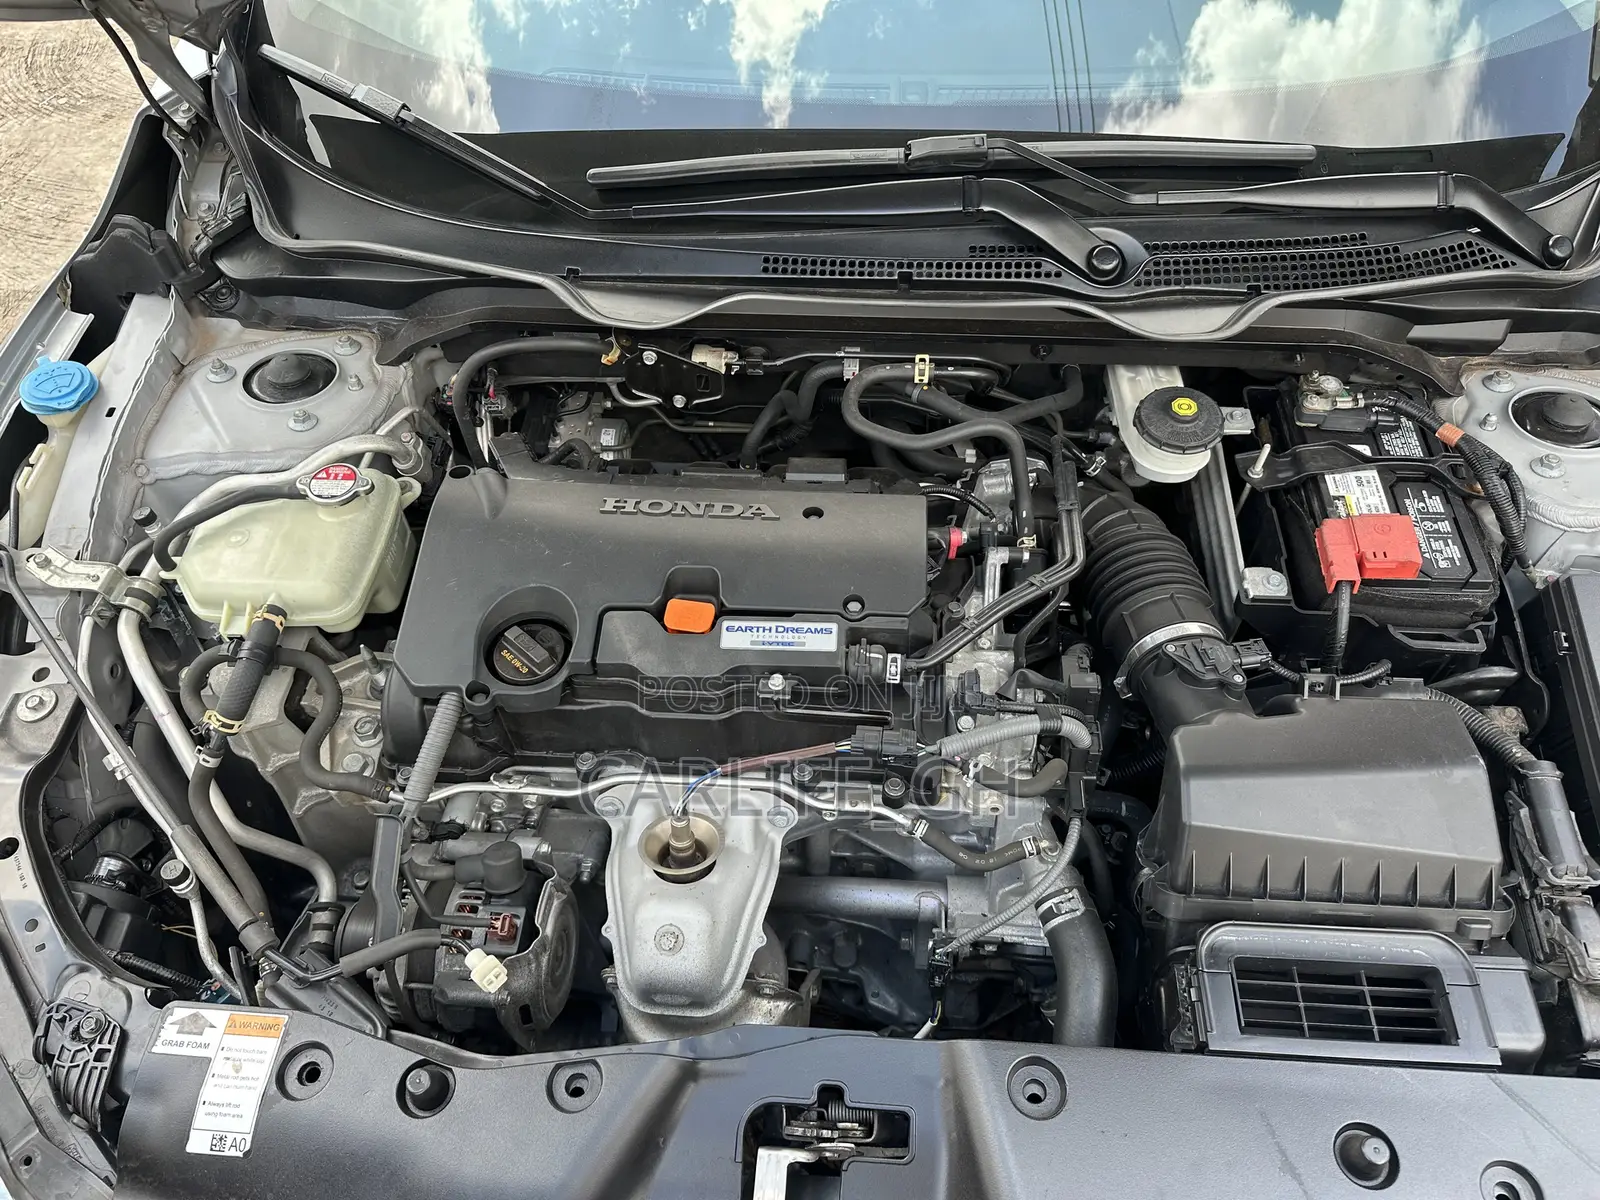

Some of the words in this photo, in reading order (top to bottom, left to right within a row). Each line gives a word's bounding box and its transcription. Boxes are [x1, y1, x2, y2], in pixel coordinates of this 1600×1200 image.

[600, 497, 780, 521] HONDA
[1403, 498, 1418, 522] POISON
[725, 625, 772, 634] EARTH
[775, 625, 833, 635] DREAMS
[500, 649, 514, 662] SAE
[511, 658, 529, 674] 0W-20
[238, 1020, 281, 1032] WARNING
[161, 1039, 185, 1048] GRAB
[186, 1041, 211, 1050] FOAM
